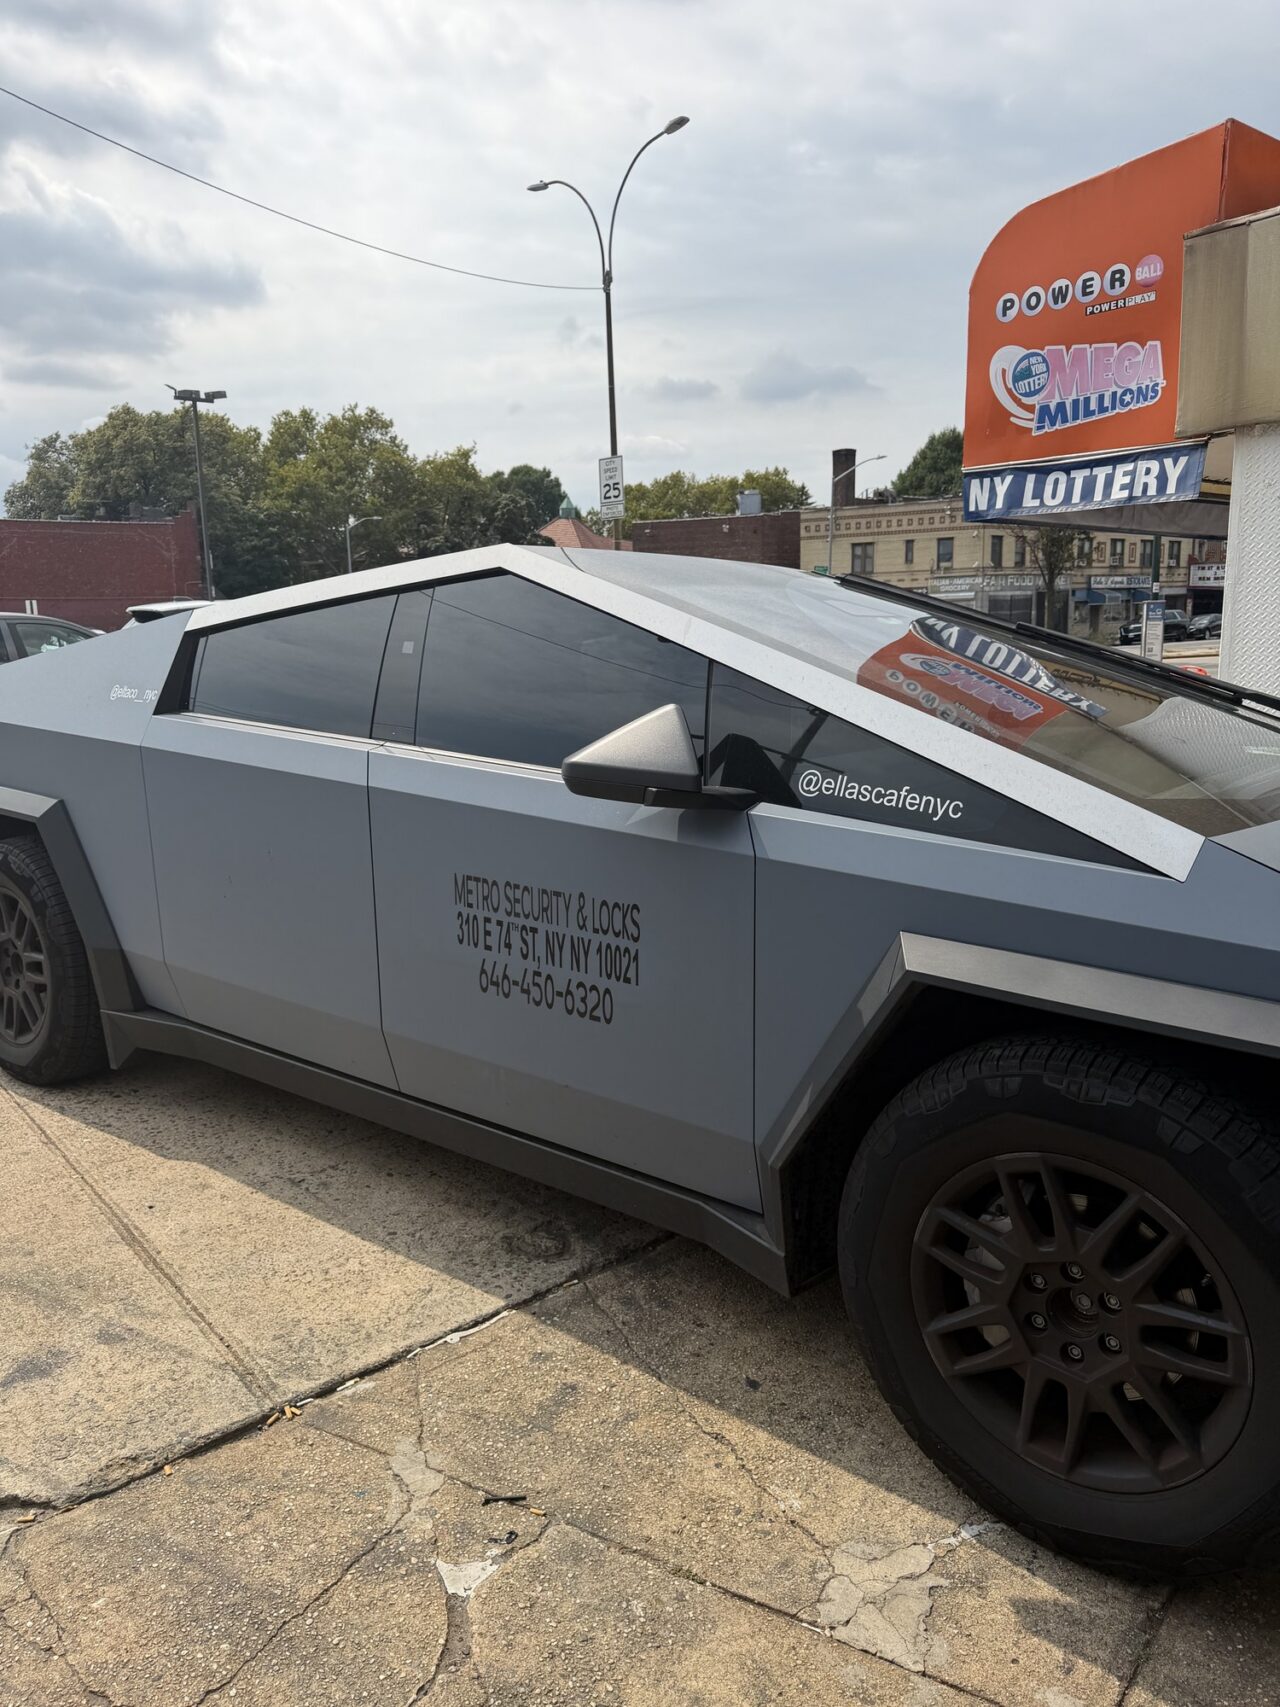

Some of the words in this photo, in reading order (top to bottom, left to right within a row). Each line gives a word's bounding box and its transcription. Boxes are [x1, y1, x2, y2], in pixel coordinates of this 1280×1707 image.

[1000, 267, 1127, 318] POWER
[1135, 262, 1164, 281] BALL
[1015, 372, 1049, 393] LOTTERY
[1029, 355, 1043, 364] NEW
[1031, 363, 1047, 375] YORK
[1038, 342, 1162, 403] MEGA
[1036, 381, 1161, 432] MILLIONS
[602, 482, 621, 500] 25
[968, 474, 1014, 512] NY
[1021, 456, 1189, 508] LOTTERY
[1008, 575, 1034, 586] FOOD
[798, 769, 964, 821] @ellascafenyc
[454, 872, 501, 914] METRO
[504, 880, 572, 928] SECURITY
[576, 892, 588, 932] &
[592, 897, 641, 943] LOCKS
[456, 911, 479, 949] 310
[483, 917, 492, 952] E
[520, 924, 541, 969] ST,
[545, 930, 566, 969] NY
[570, 935, 592, 974] NY
[596, 942, 640, 986] 10021
[479, 958, 613, 1025] 646-450-6320
